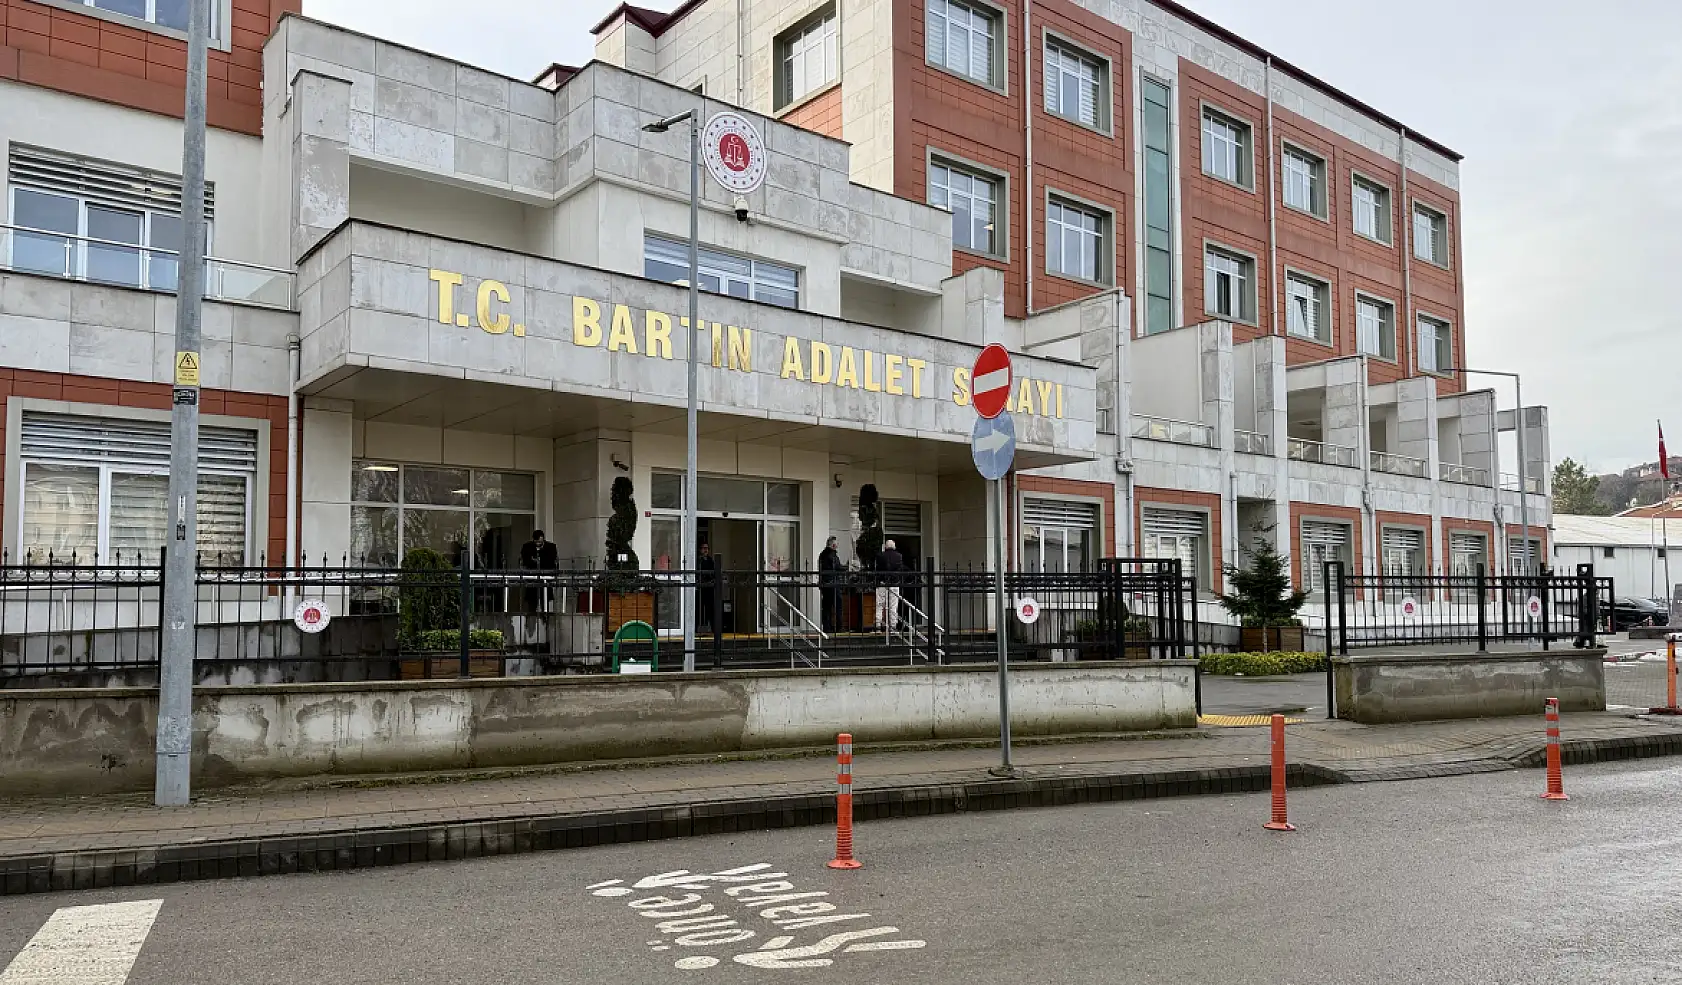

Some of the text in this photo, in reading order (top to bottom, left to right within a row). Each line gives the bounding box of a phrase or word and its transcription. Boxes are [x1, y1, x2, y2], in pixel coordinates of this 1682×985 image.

[429, 269, 526, 337] T.C.
[780, 336, 926, 399] ADALET
[952, 366, 1063, 418] SAYI
